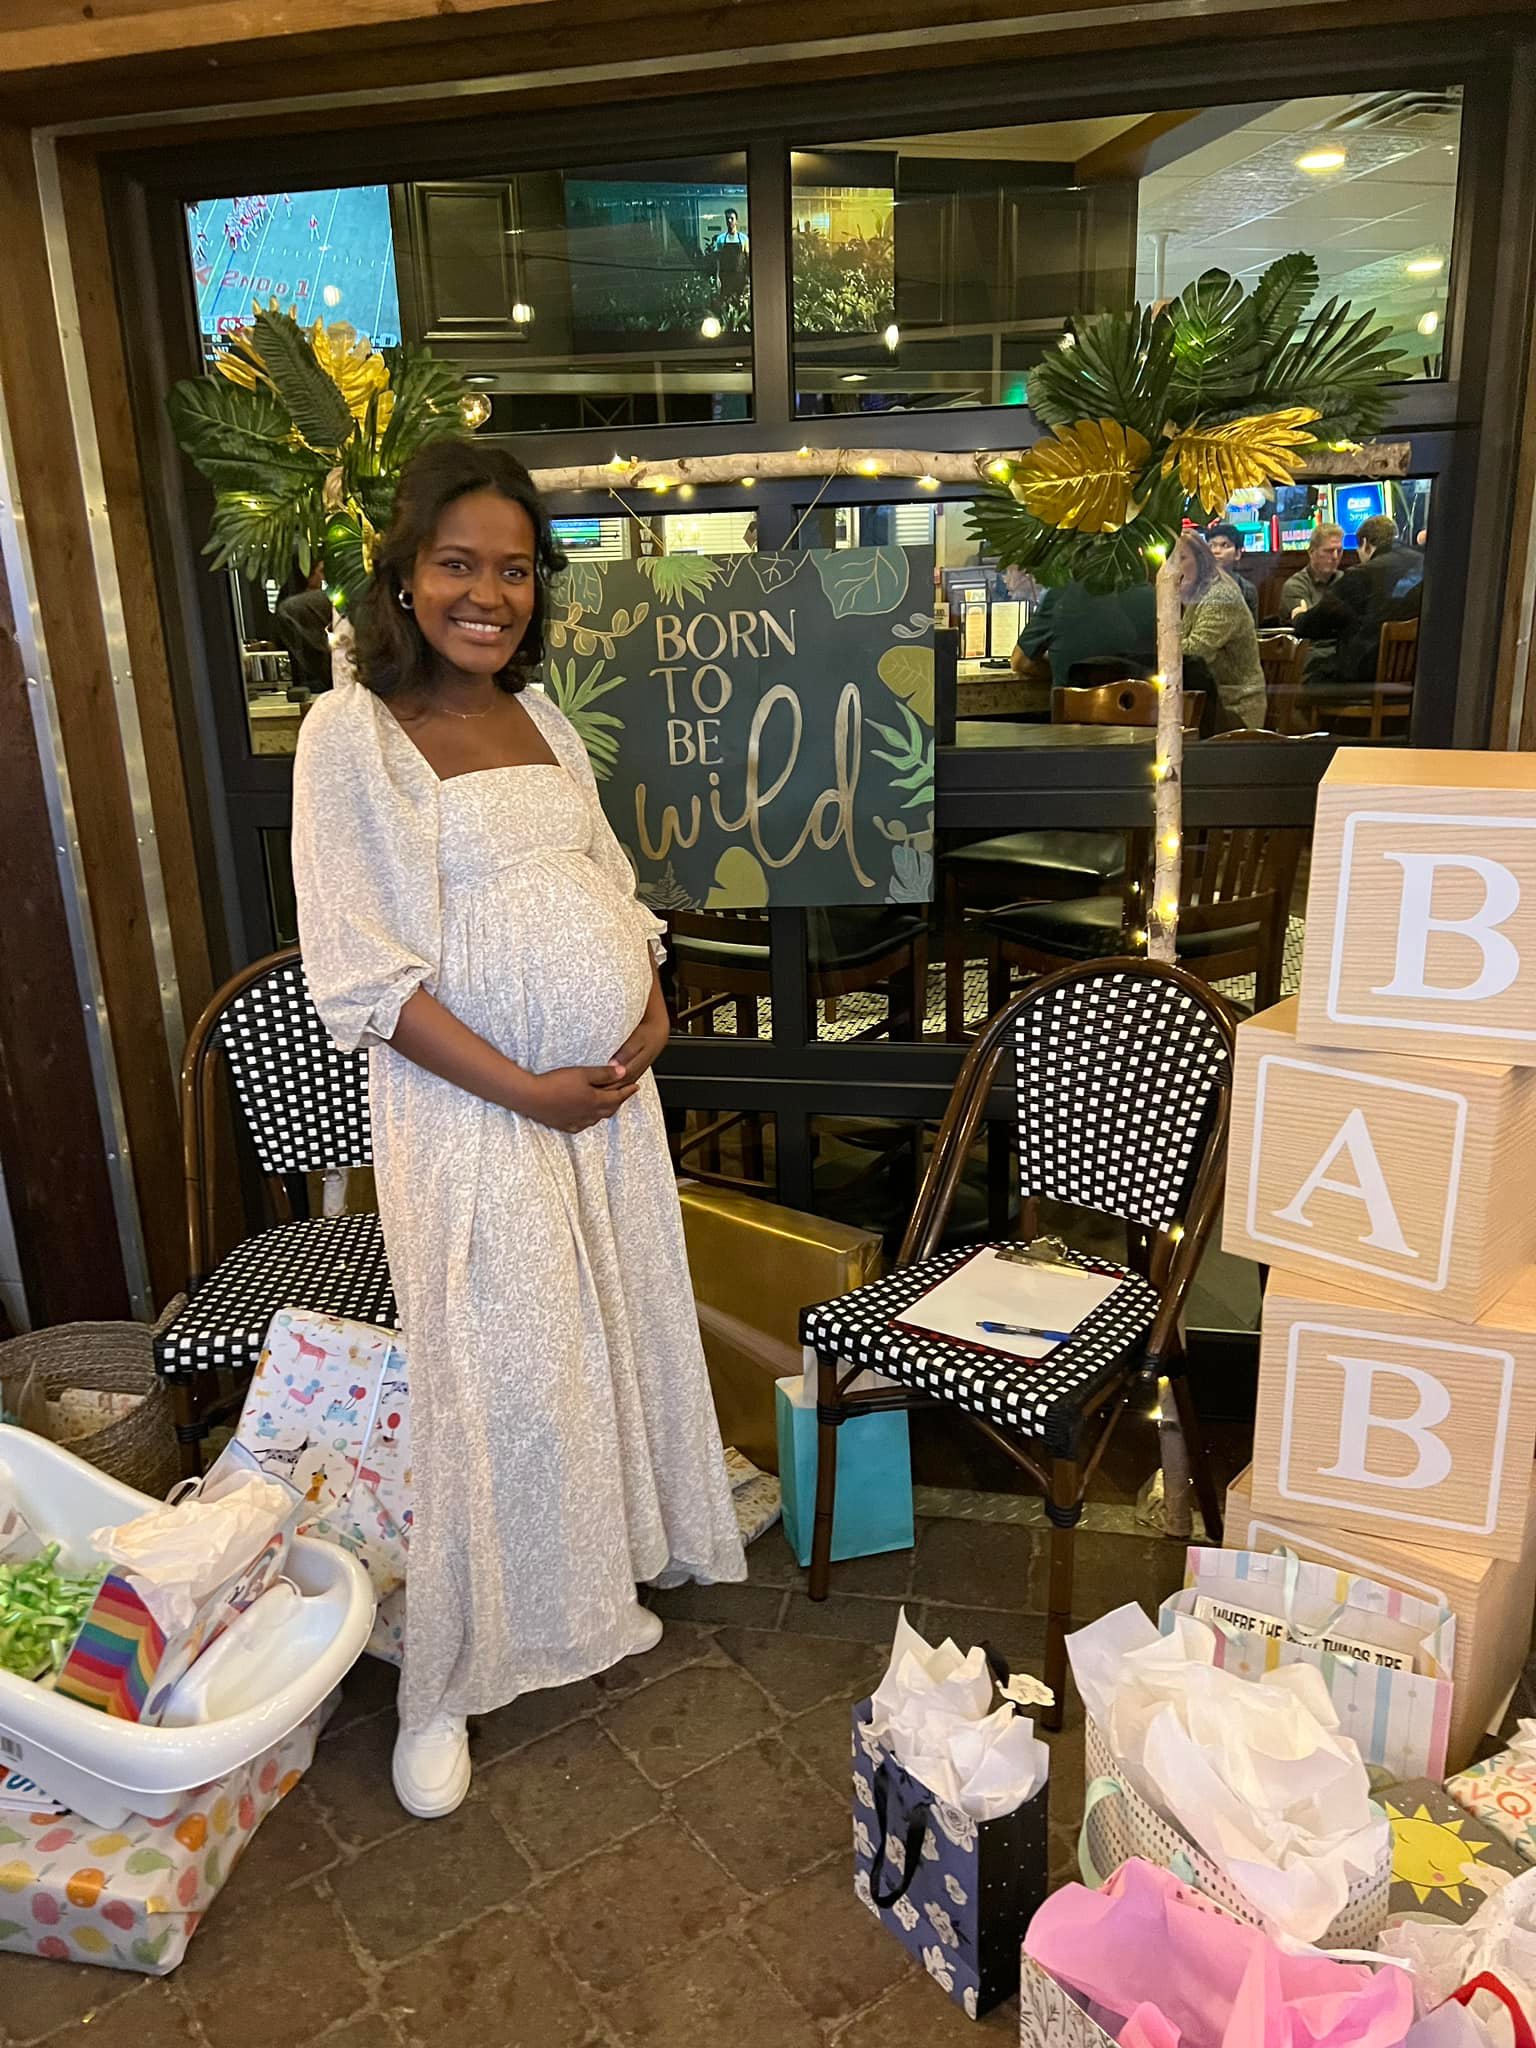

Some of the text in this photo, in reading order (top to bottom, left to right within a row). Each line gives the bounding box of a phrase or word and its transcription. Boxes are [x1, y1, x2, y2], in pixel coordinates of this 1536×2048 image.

[656, 609, 796, 662] BORN
[649, 664, 732, 714] TO
[635, 682, 875, 888] wild
[667, 719, 723, 766] BE
[1370, 851, 1521, 1001] B
[1271, 1107, 1419, 1259] A
[1316, 1354, 1453, 1490] B
[1259, 1619, 1283, 1639] THE
